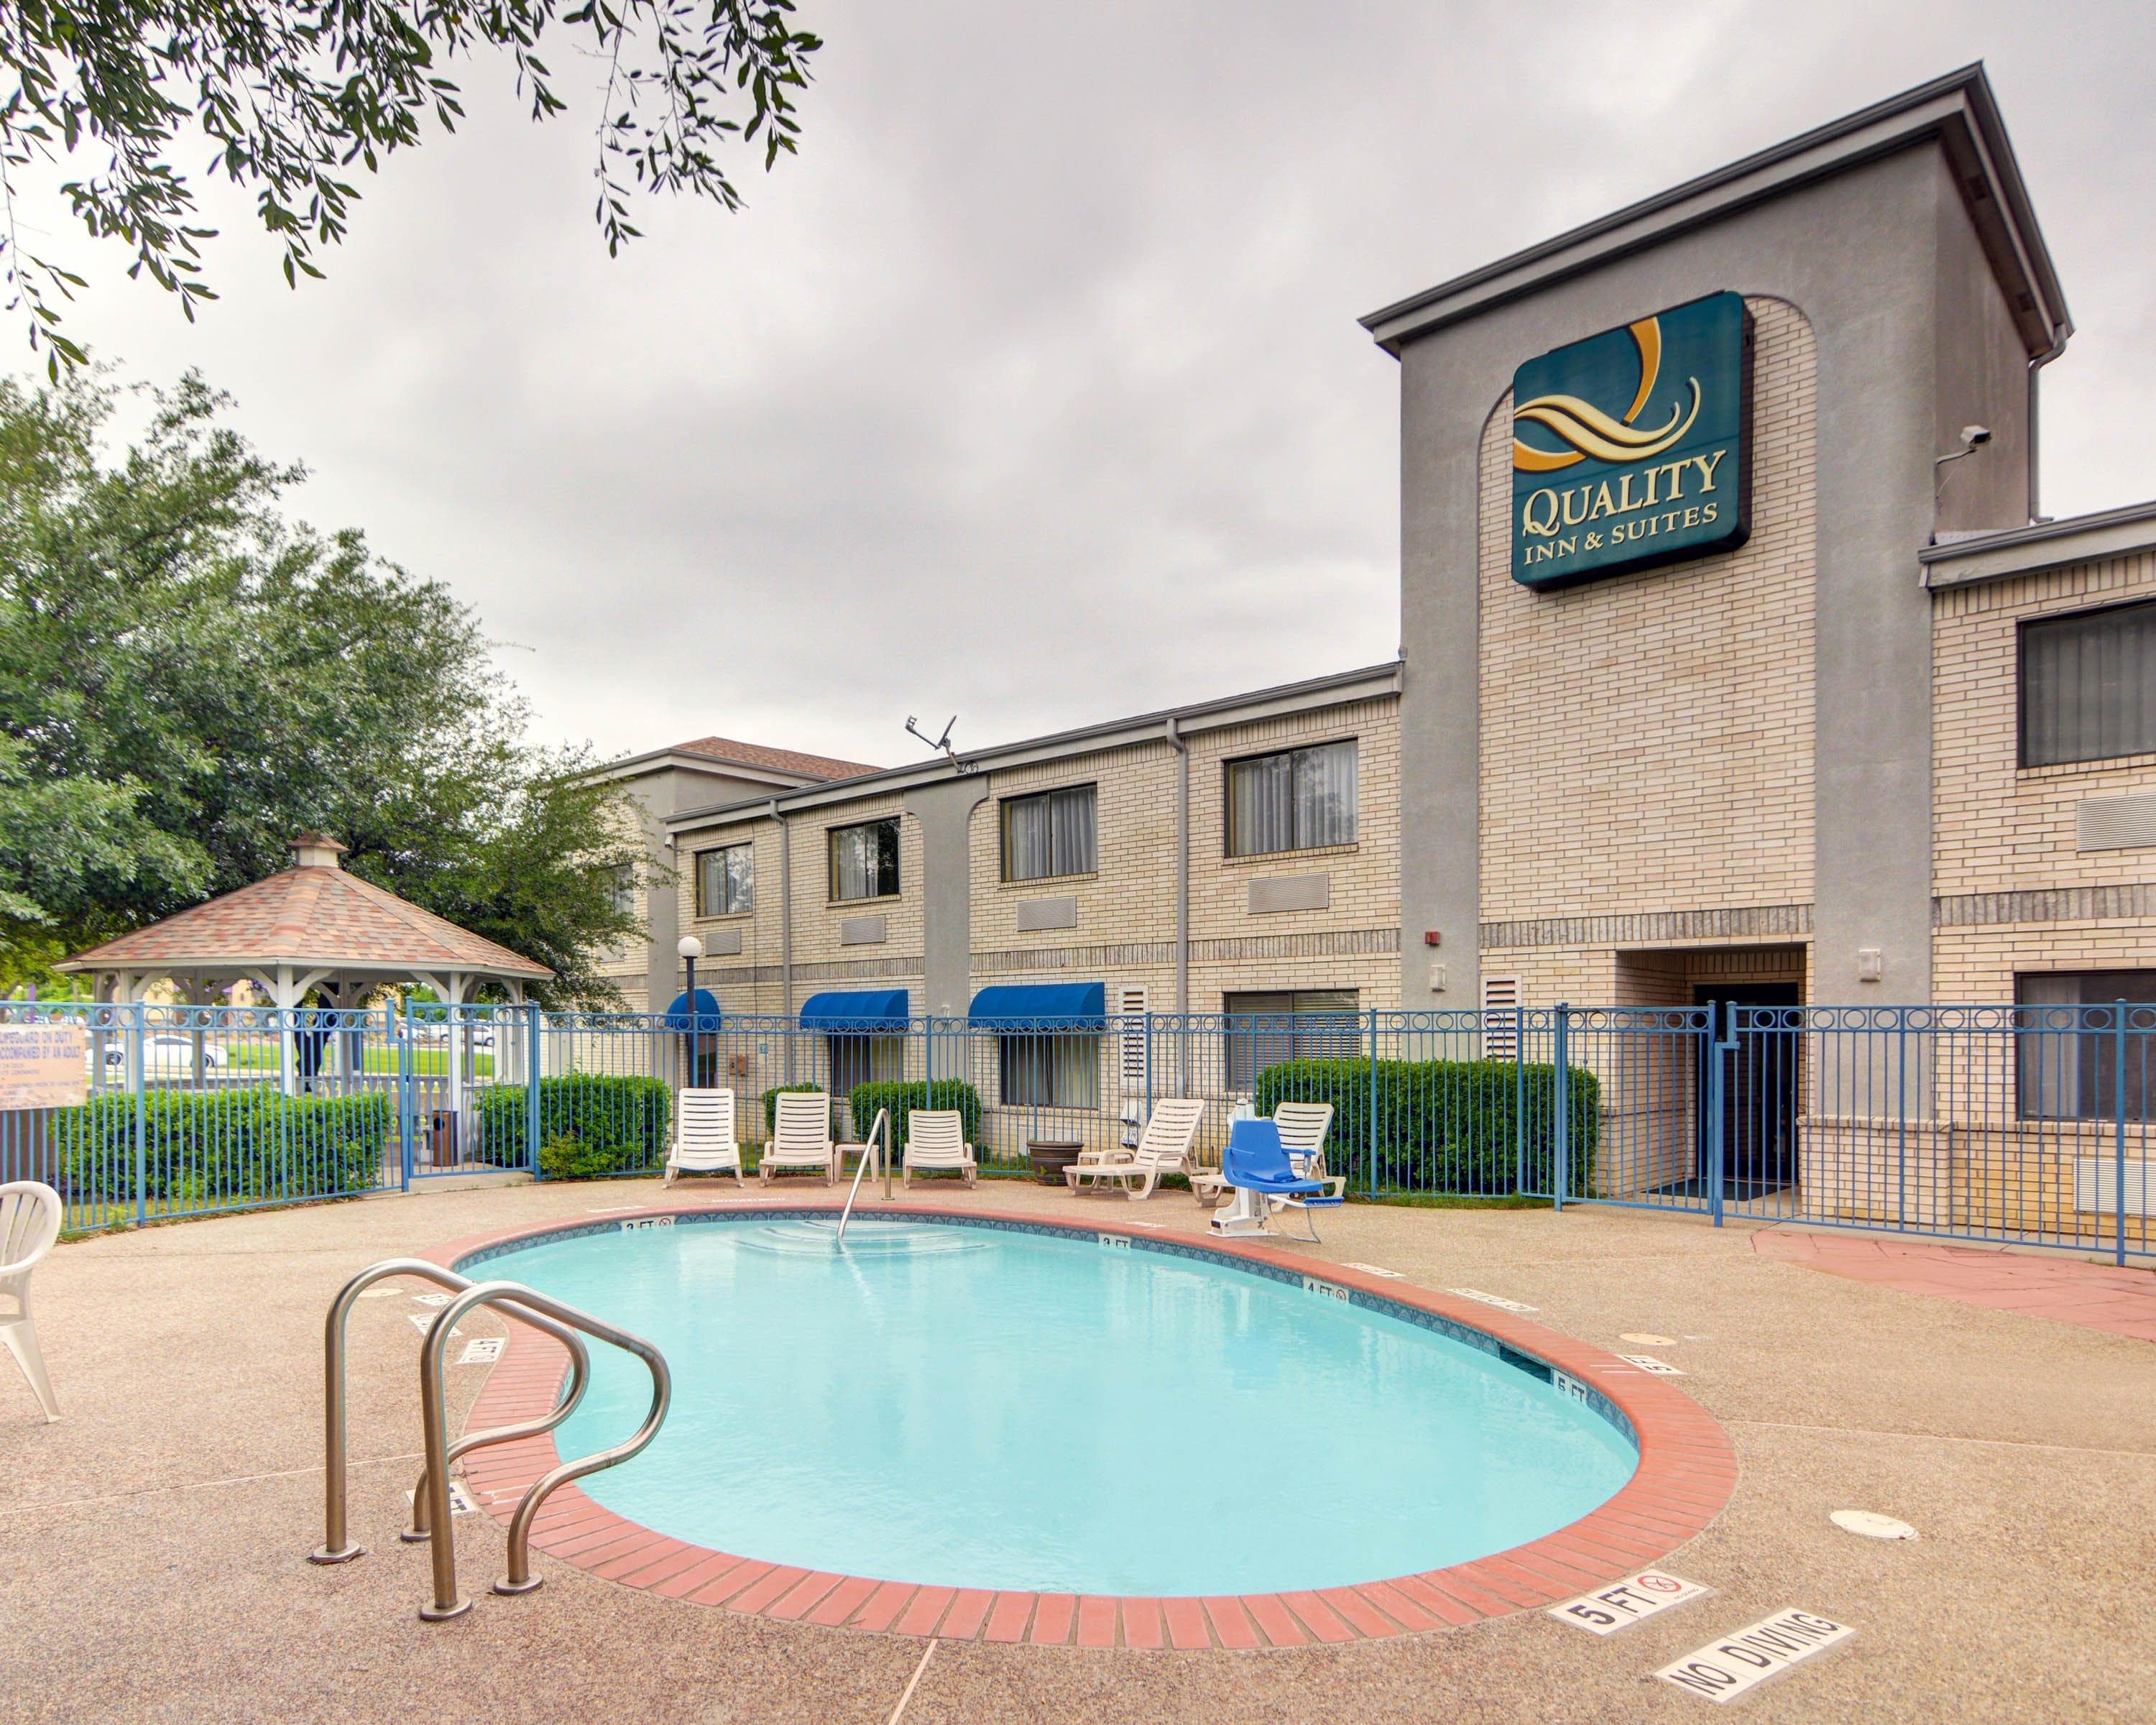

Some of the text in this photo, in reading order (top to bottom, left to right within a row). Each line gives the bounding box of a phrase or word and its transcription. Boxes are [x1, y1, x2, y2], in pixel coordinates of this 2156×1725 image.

[1522, 450, 1726, 536] QUALITY
[1524, 502, 1718, 565] INN & SUITES
[1558, 1376, 1585, 1402] 5 FT
[1566, 1586, 1657, 1626] 5 FT
[1669, 1614, 1841, 1696] NO DIVING
